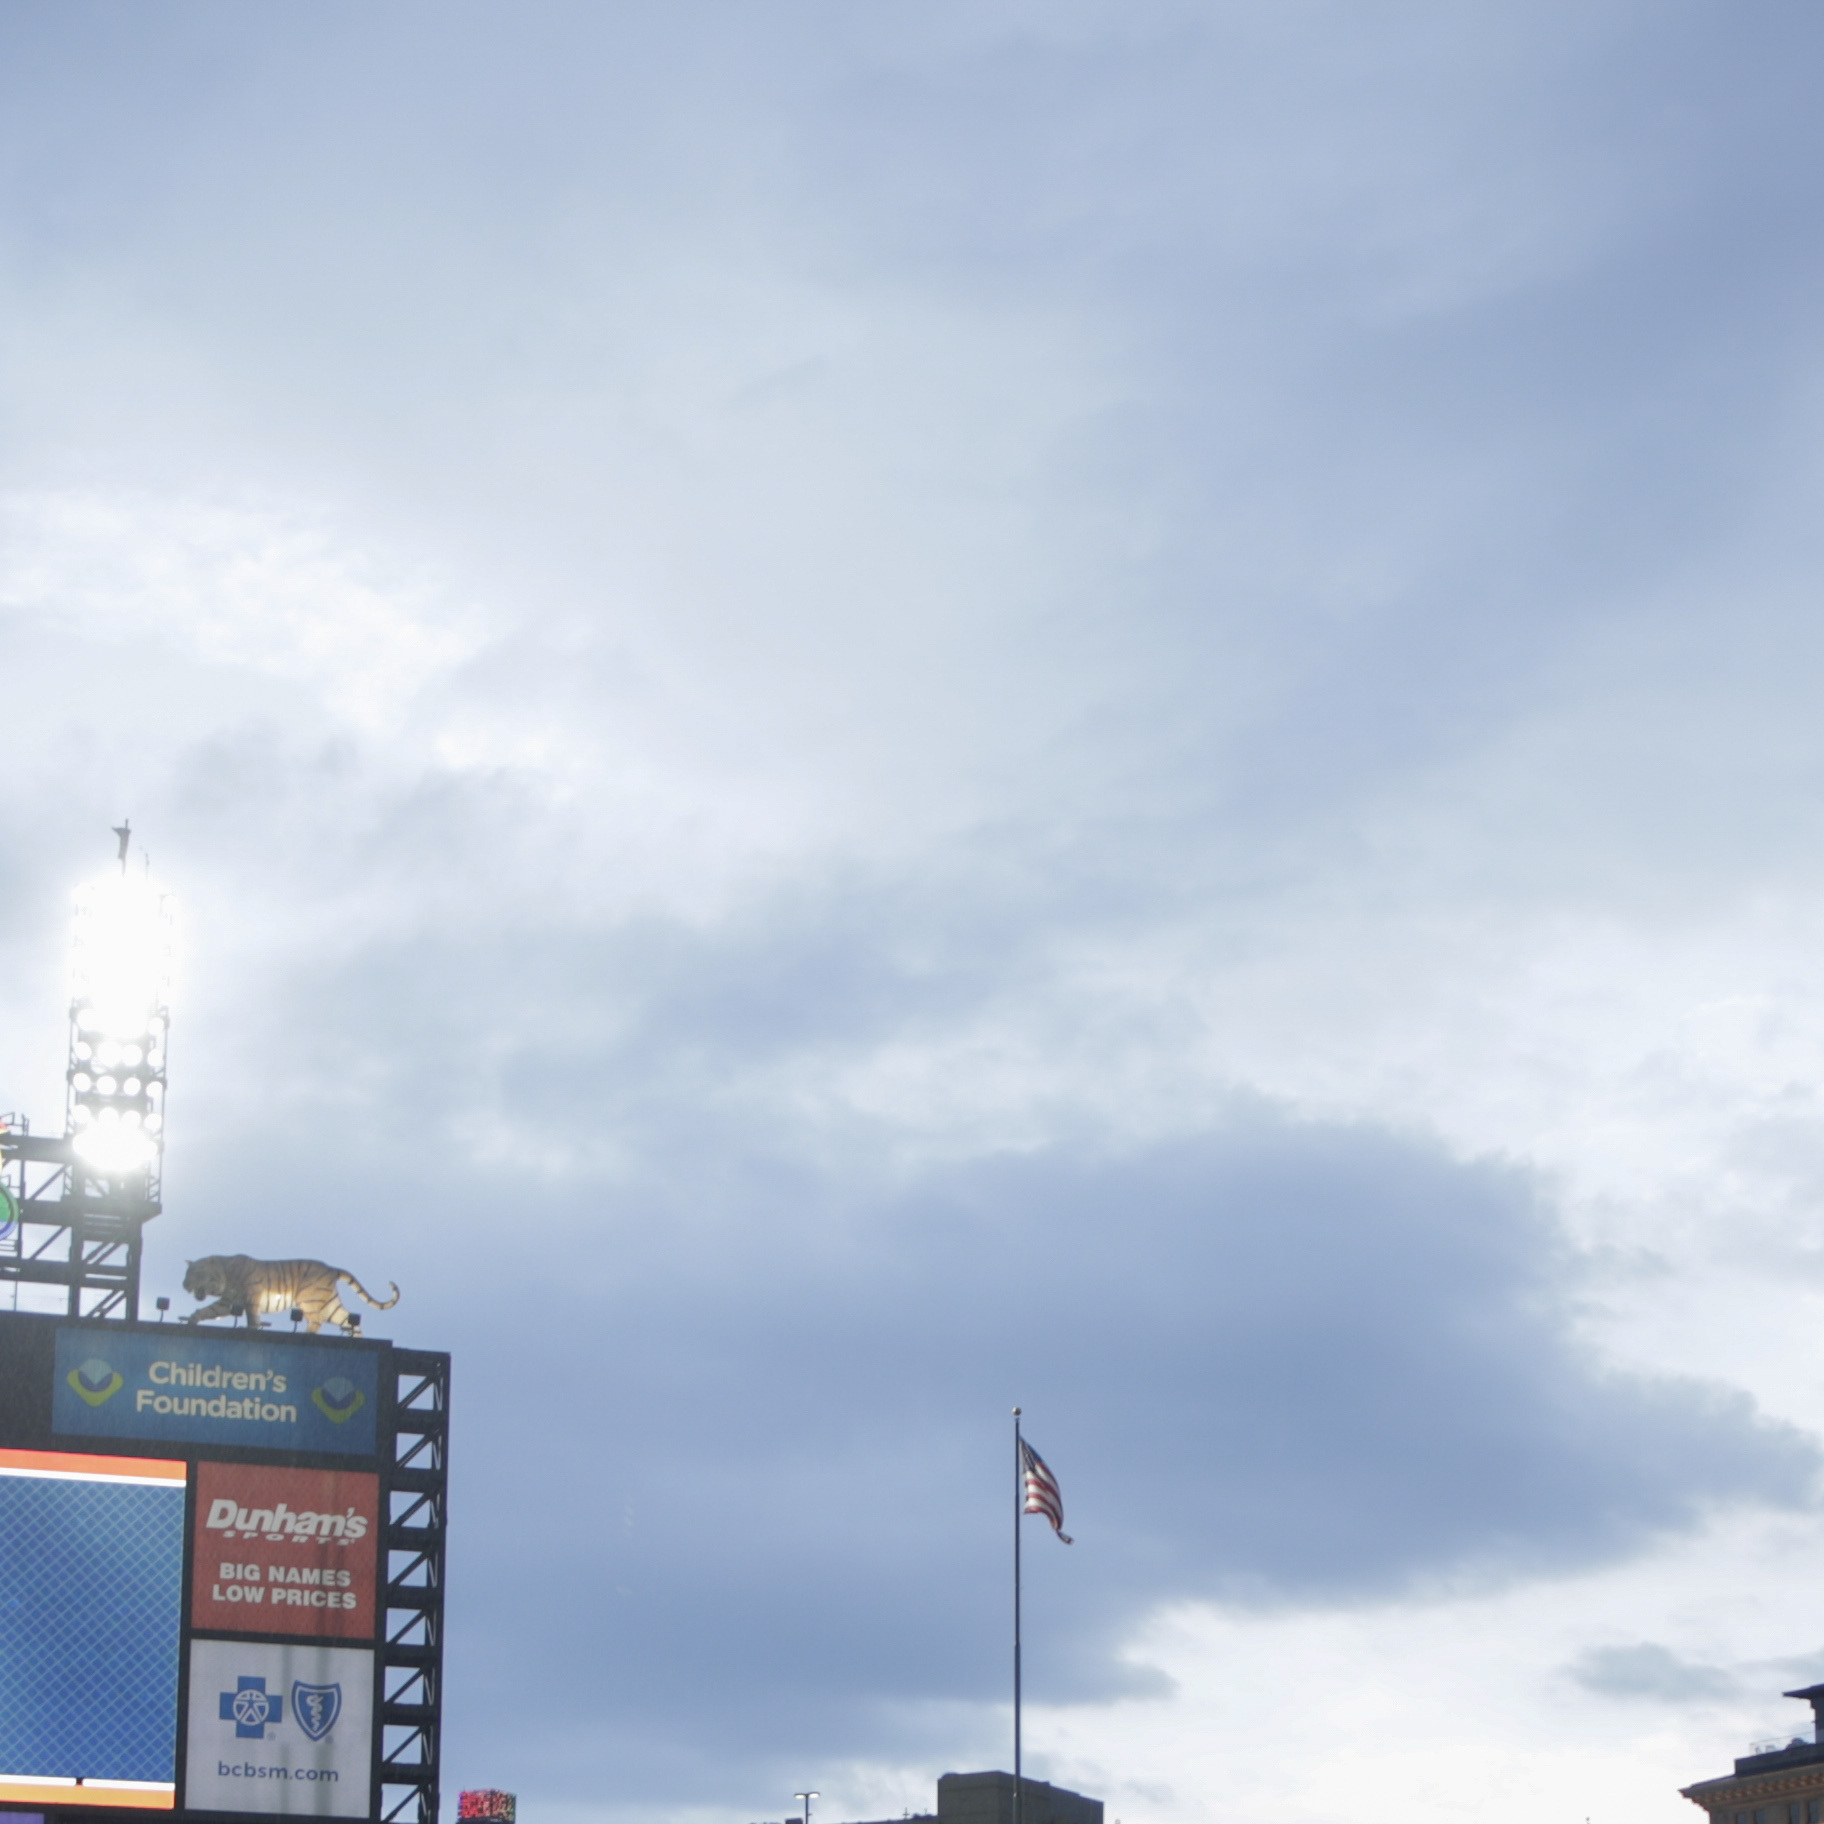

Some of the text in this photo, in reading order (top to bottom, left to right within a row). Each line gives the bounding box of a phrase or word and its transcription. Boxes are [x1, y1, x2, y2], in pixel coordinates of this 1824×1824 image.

[148, 1360, 287, 1394] Children's
[135, 1390, 298, 1425] Foundation
[206, 1498, 369, 1539] Dunham's
[219, 1562, 352, 1588] BIG NAMES
[212, 1584, 358, 1611] LOW PRICES
[217, 1760, 340, 1783] bcbsm.com
